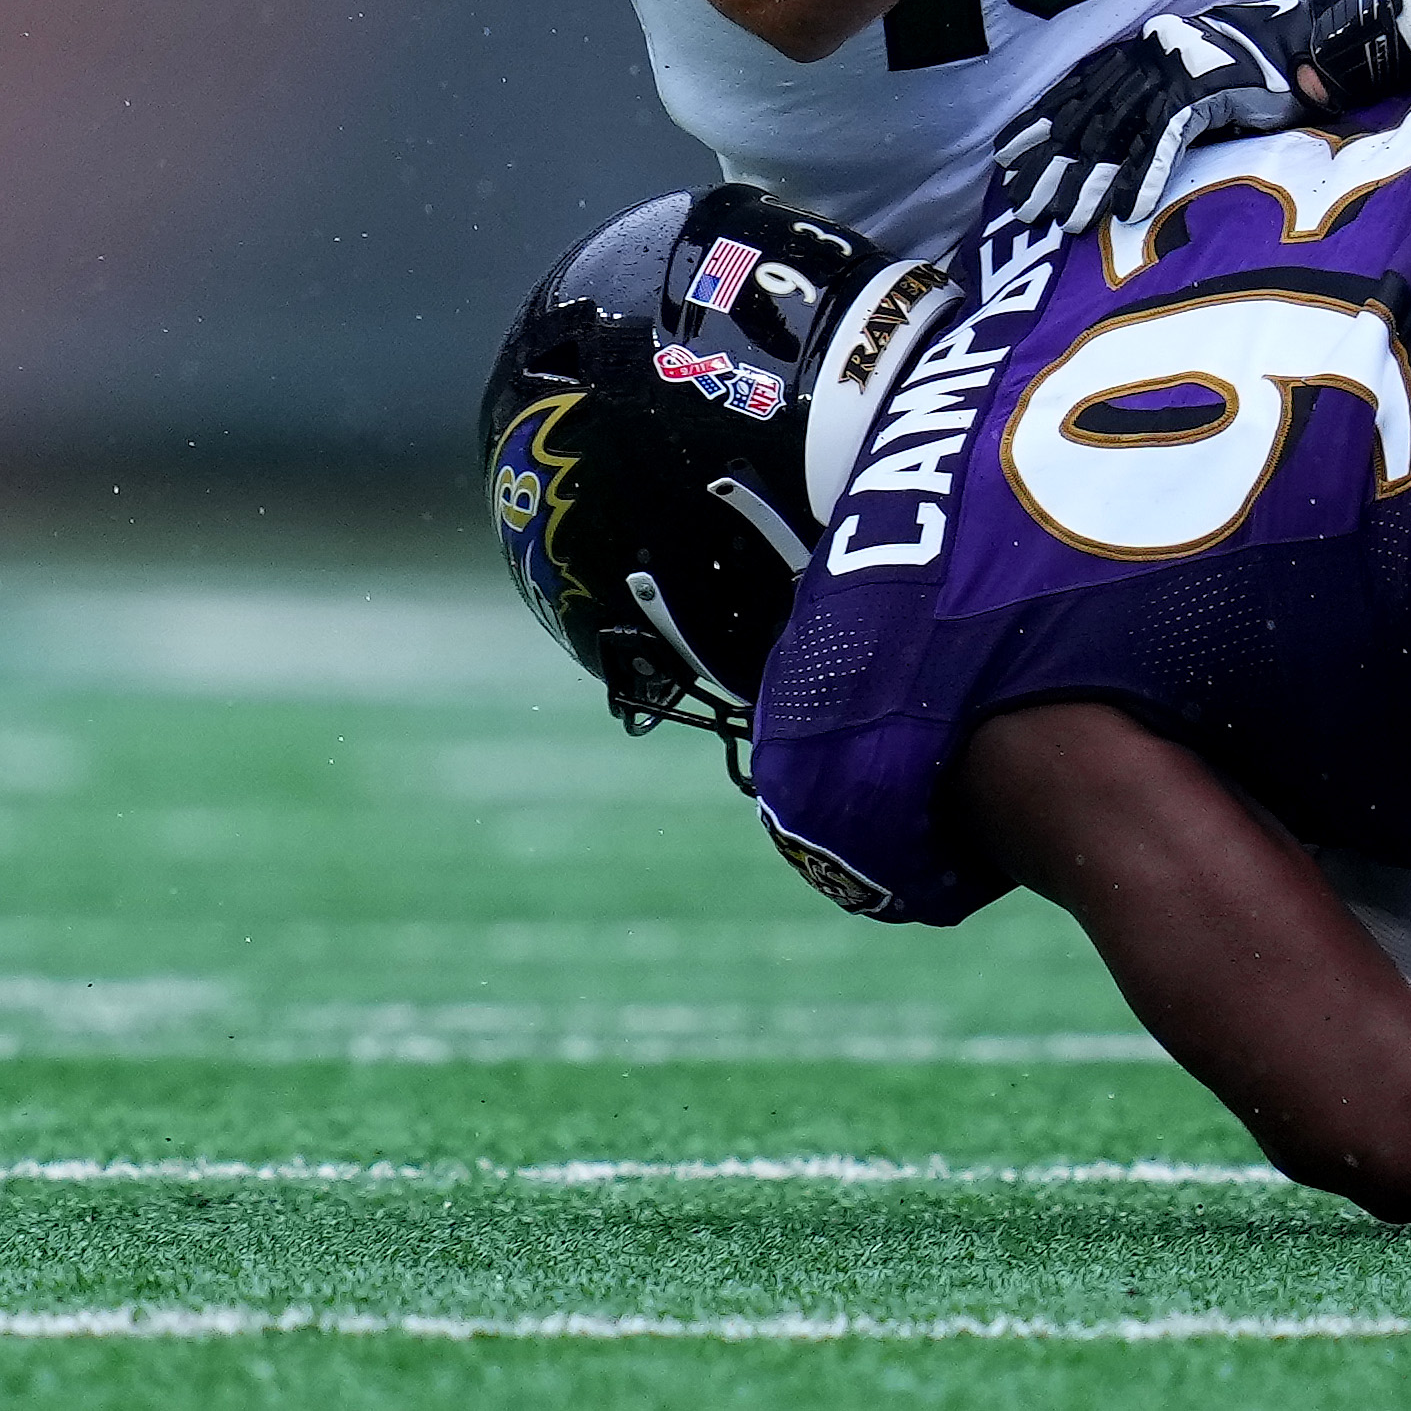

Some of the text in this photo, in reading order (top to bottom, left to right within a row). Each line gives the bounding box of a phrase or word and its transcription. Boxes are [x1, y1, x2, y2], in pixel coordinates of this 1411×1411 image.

[754, 221, 853, 305] 93
[680, 361, 707, 377] 9/11
[747, 381, 779, 414] NFL
